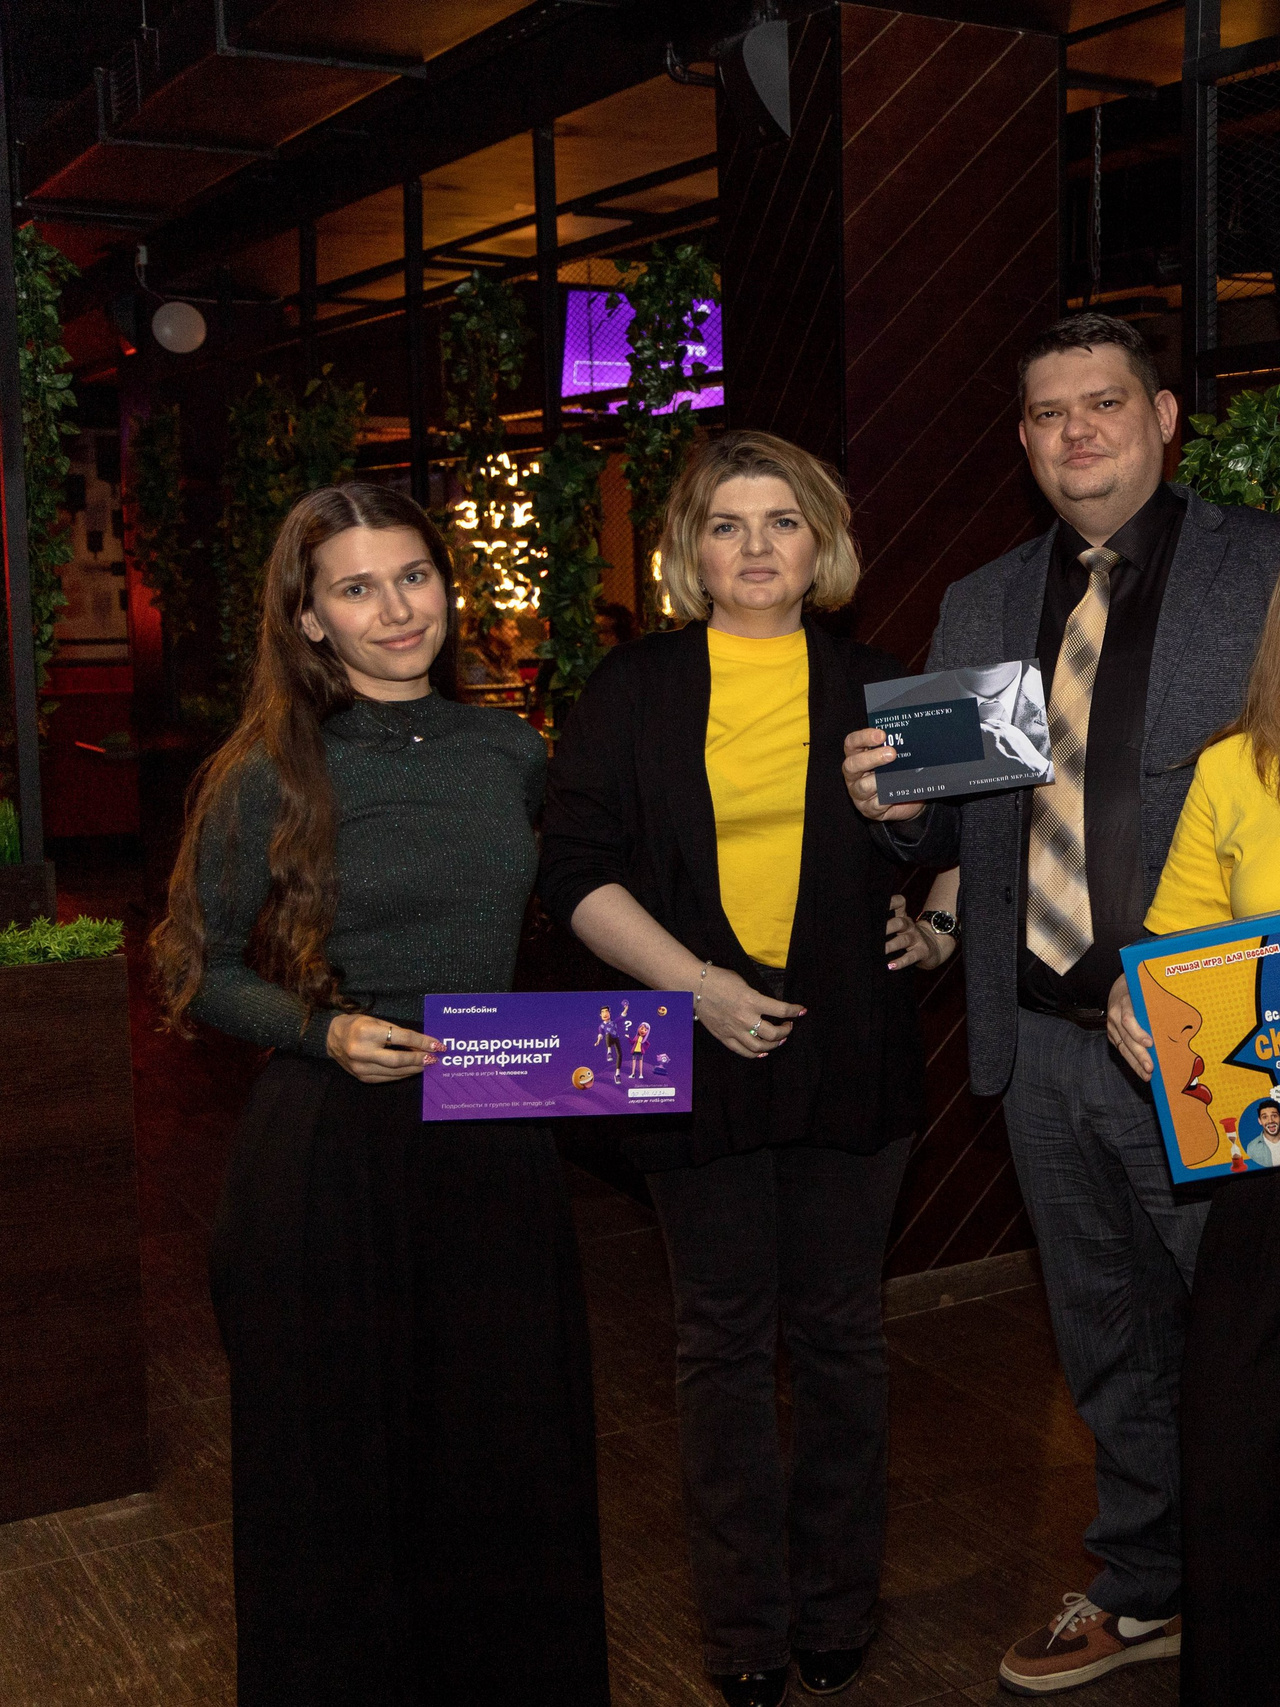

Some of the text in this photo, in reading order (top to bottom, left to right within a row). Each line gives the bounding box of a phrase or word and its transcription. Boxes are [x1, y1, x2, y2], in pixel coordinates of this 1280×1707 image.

[875, 714, 900, 725] КУПОН
[914, 707, 953, 719] МУЖСКУЮ
[443, 1005, 497, 1014] Мозгобойня
[443, 1035, 560, 1053] Подарочный
[442, 1051, 553, 1068] сертификат
[451, 1071, 474, 1079] участие
[441, 1102, 483, 1110] Подробности
[489, 1101, 511, 1109] группе
